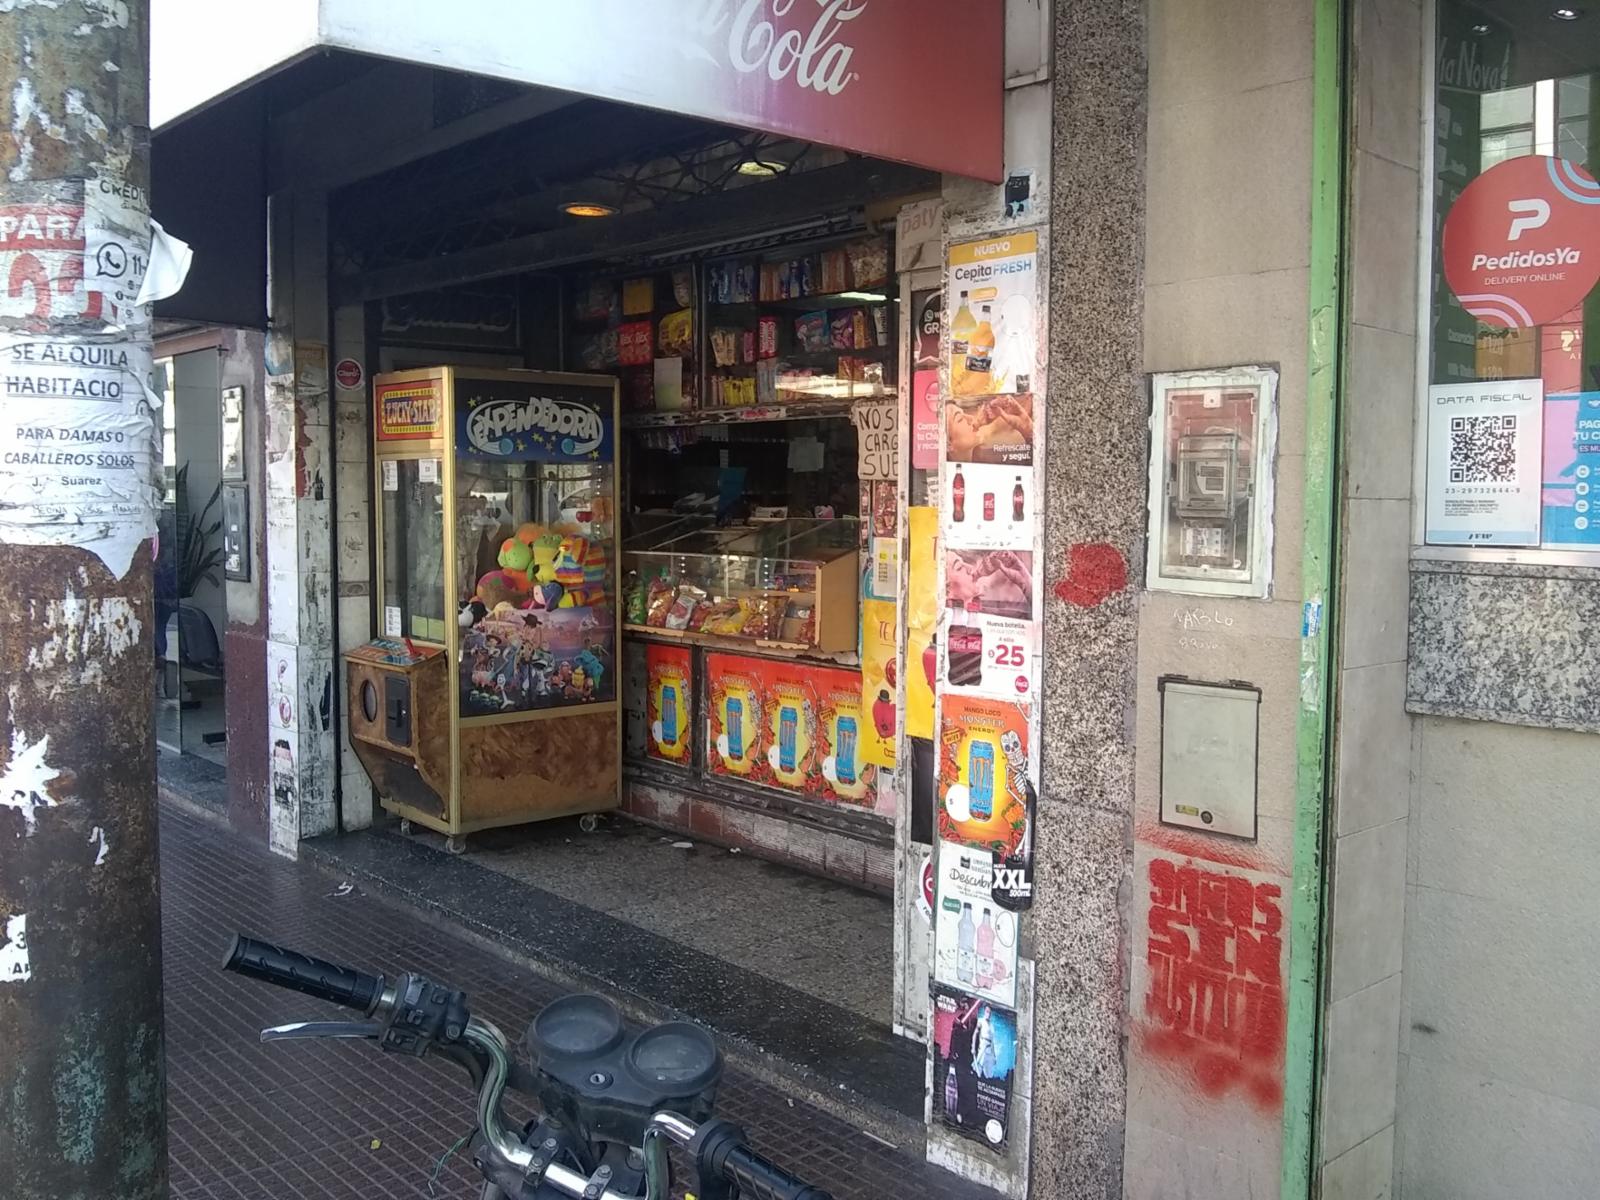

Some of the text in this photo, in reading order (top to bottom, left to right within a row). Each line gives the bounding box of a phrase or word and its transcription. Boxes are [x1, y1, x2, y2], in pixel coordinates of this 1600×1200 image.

[727, 0, 856, 96] Cola
[974, 241, 1011, 257] NUEVO
[1471, 247, 1581, 271] PedidosYa
[955, 259, 1032, 281] Cepita FRESH
[1484, 272, 1566, 286] DELIVERY ONLINE
[12, 344, 128, 367] SE ALQUILA
[6, 376, 120, 398] HABITACIO
[1437, 393, 1532, 405] DATA FISCAL
[385, 400, 411, 424] LUCKY
[472, 396, 598, 445] EXPENDEDORA
[858, 408, 880, 431] NO
[16, 428, 124, 443] PARA DAMAS O
[993, 443, 1031, 453] Refrescate
[4, 452, 135, 468] CABALLEROS SOLOS
[1002, 454, 1008, 462] y
[61, 476, 102, 486] Suarez
[969, 726, 995, 734] ENERGY
[992, 868, 1032, 890] XXL
